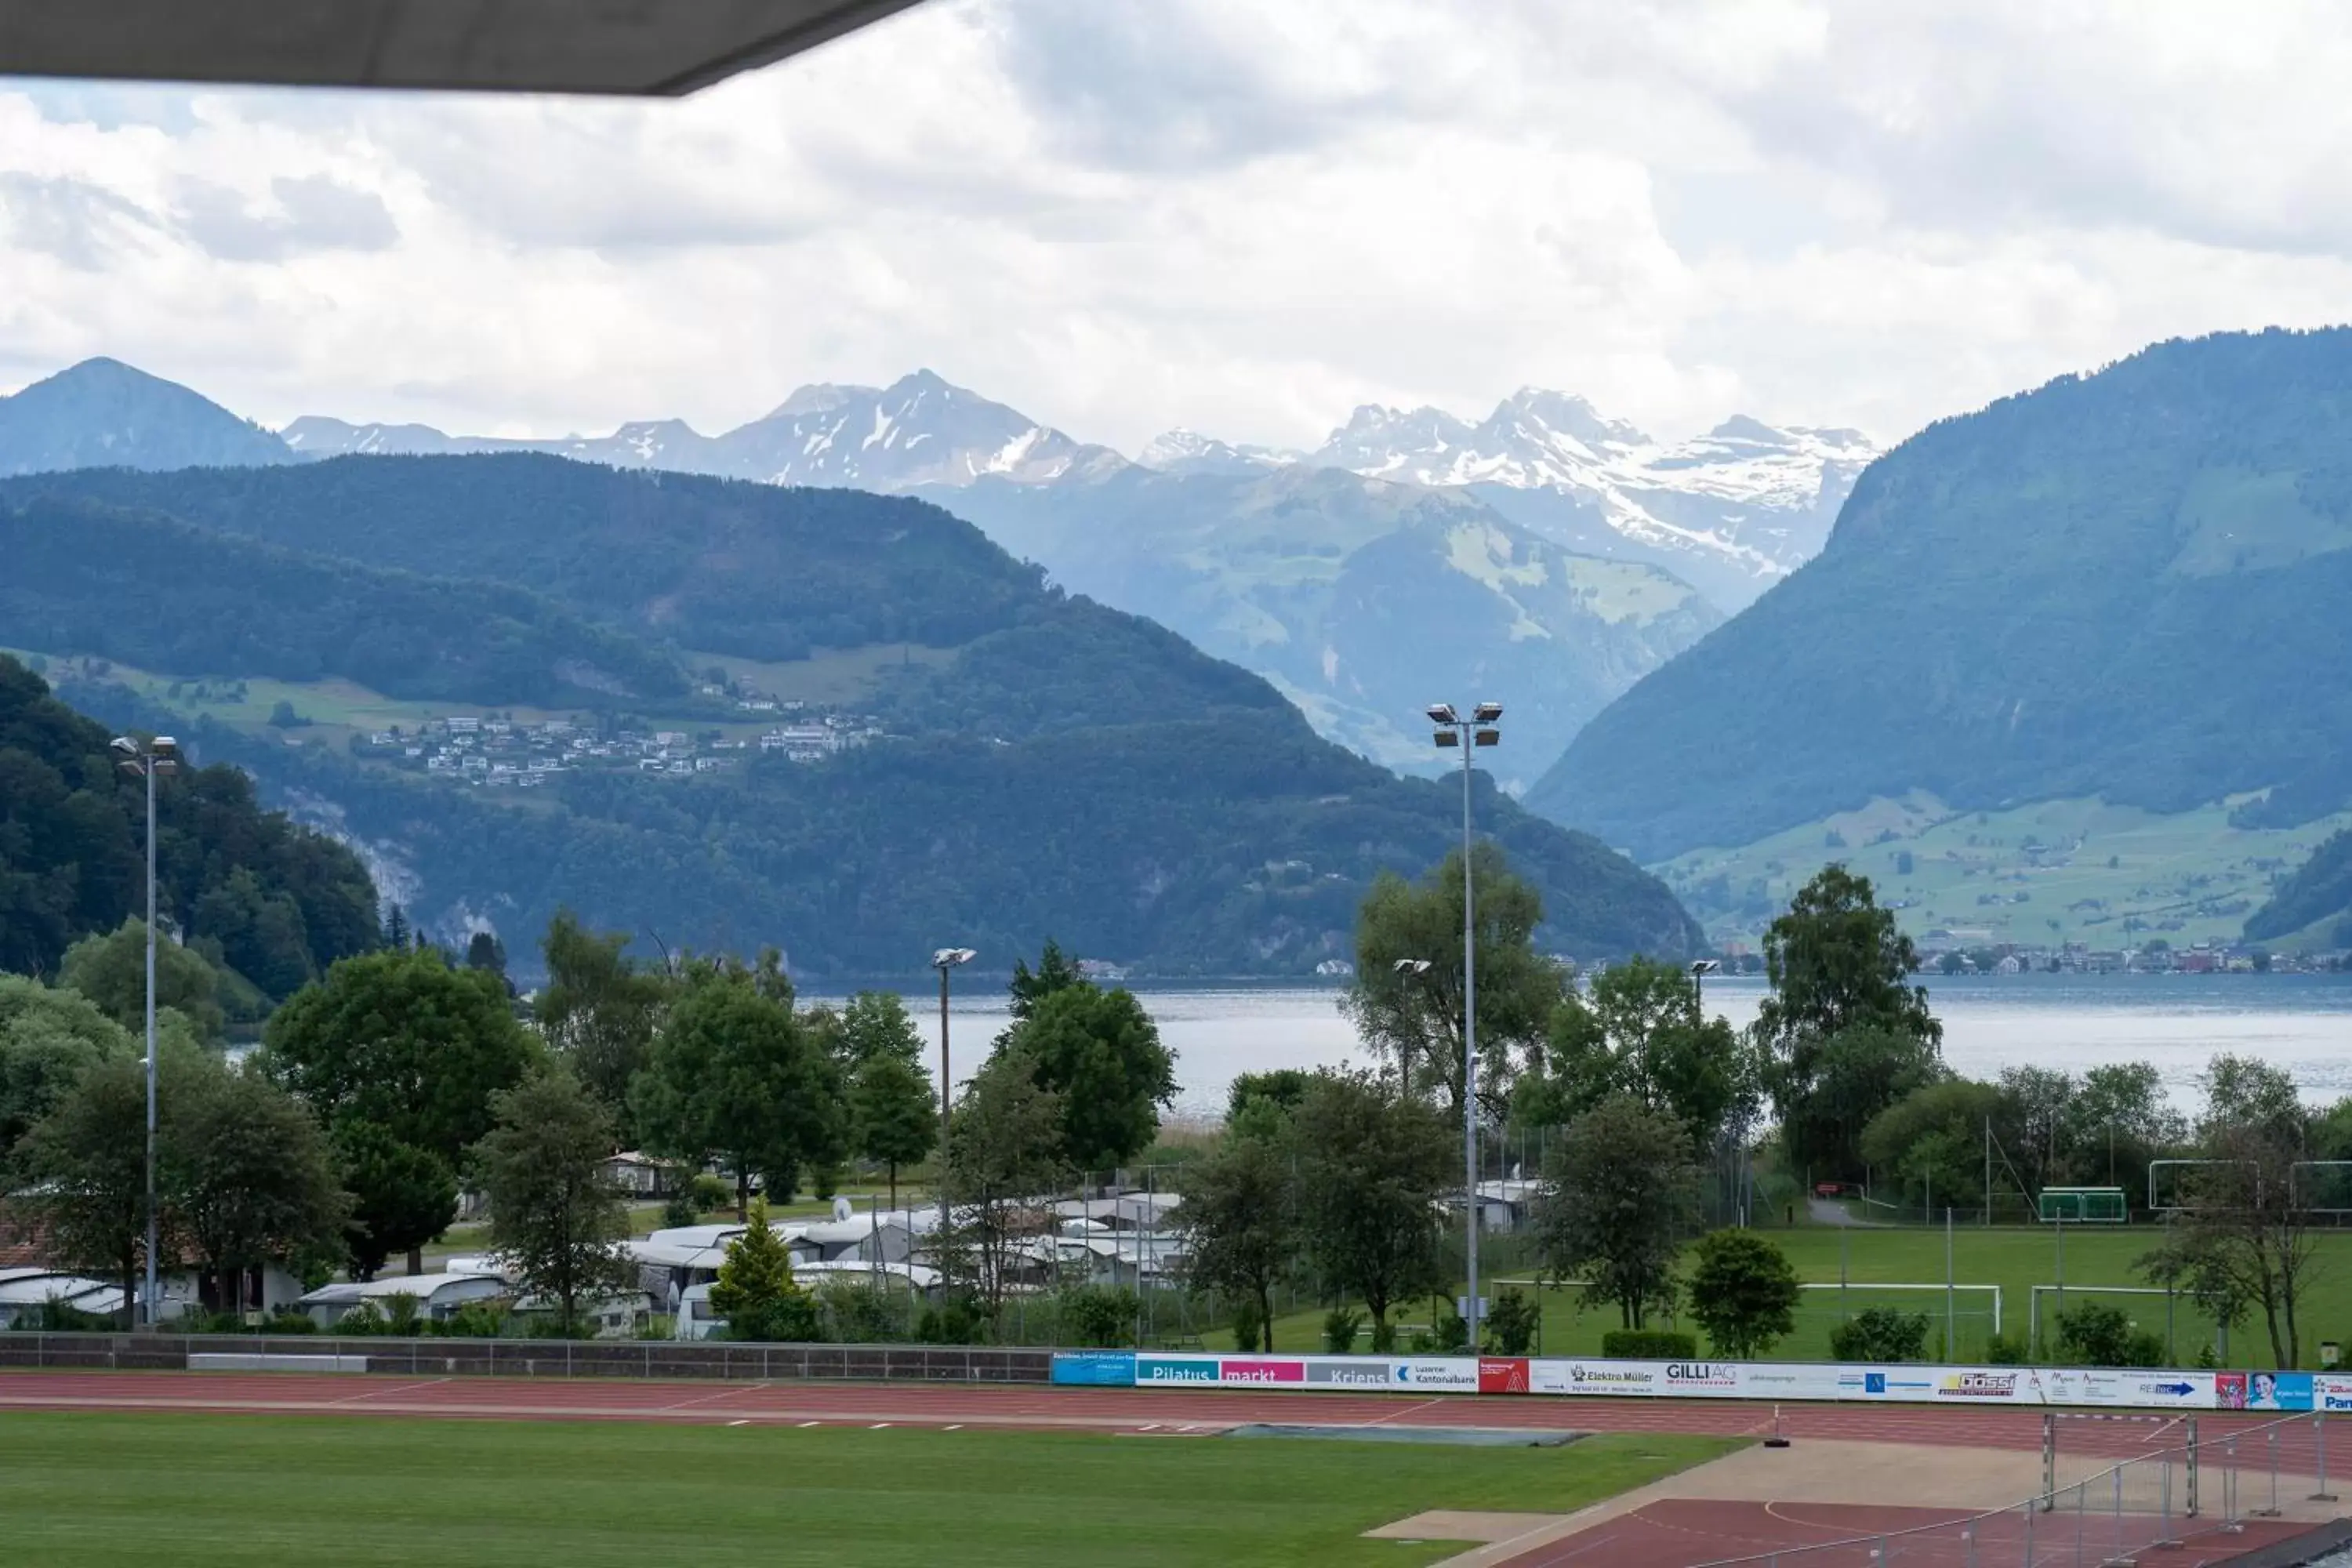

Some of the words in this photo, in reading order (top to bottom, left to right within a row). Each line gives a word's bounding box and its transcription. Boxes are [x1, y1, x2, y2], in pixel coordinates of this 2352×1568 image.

[1152, 1367, 1210, 1380] Pilatus
[1225, 1368, 1276, 1381] markt
[1331, 1370, 1386, 1384] Kriens
[1624, 1371, 1653, 1382] Müller
[1667, 1364, 1709, 1379] GILLI
[1711, 1365, 1737, 1380] AG
[1415, 1374, 1476, 1384] Kantonalbank
